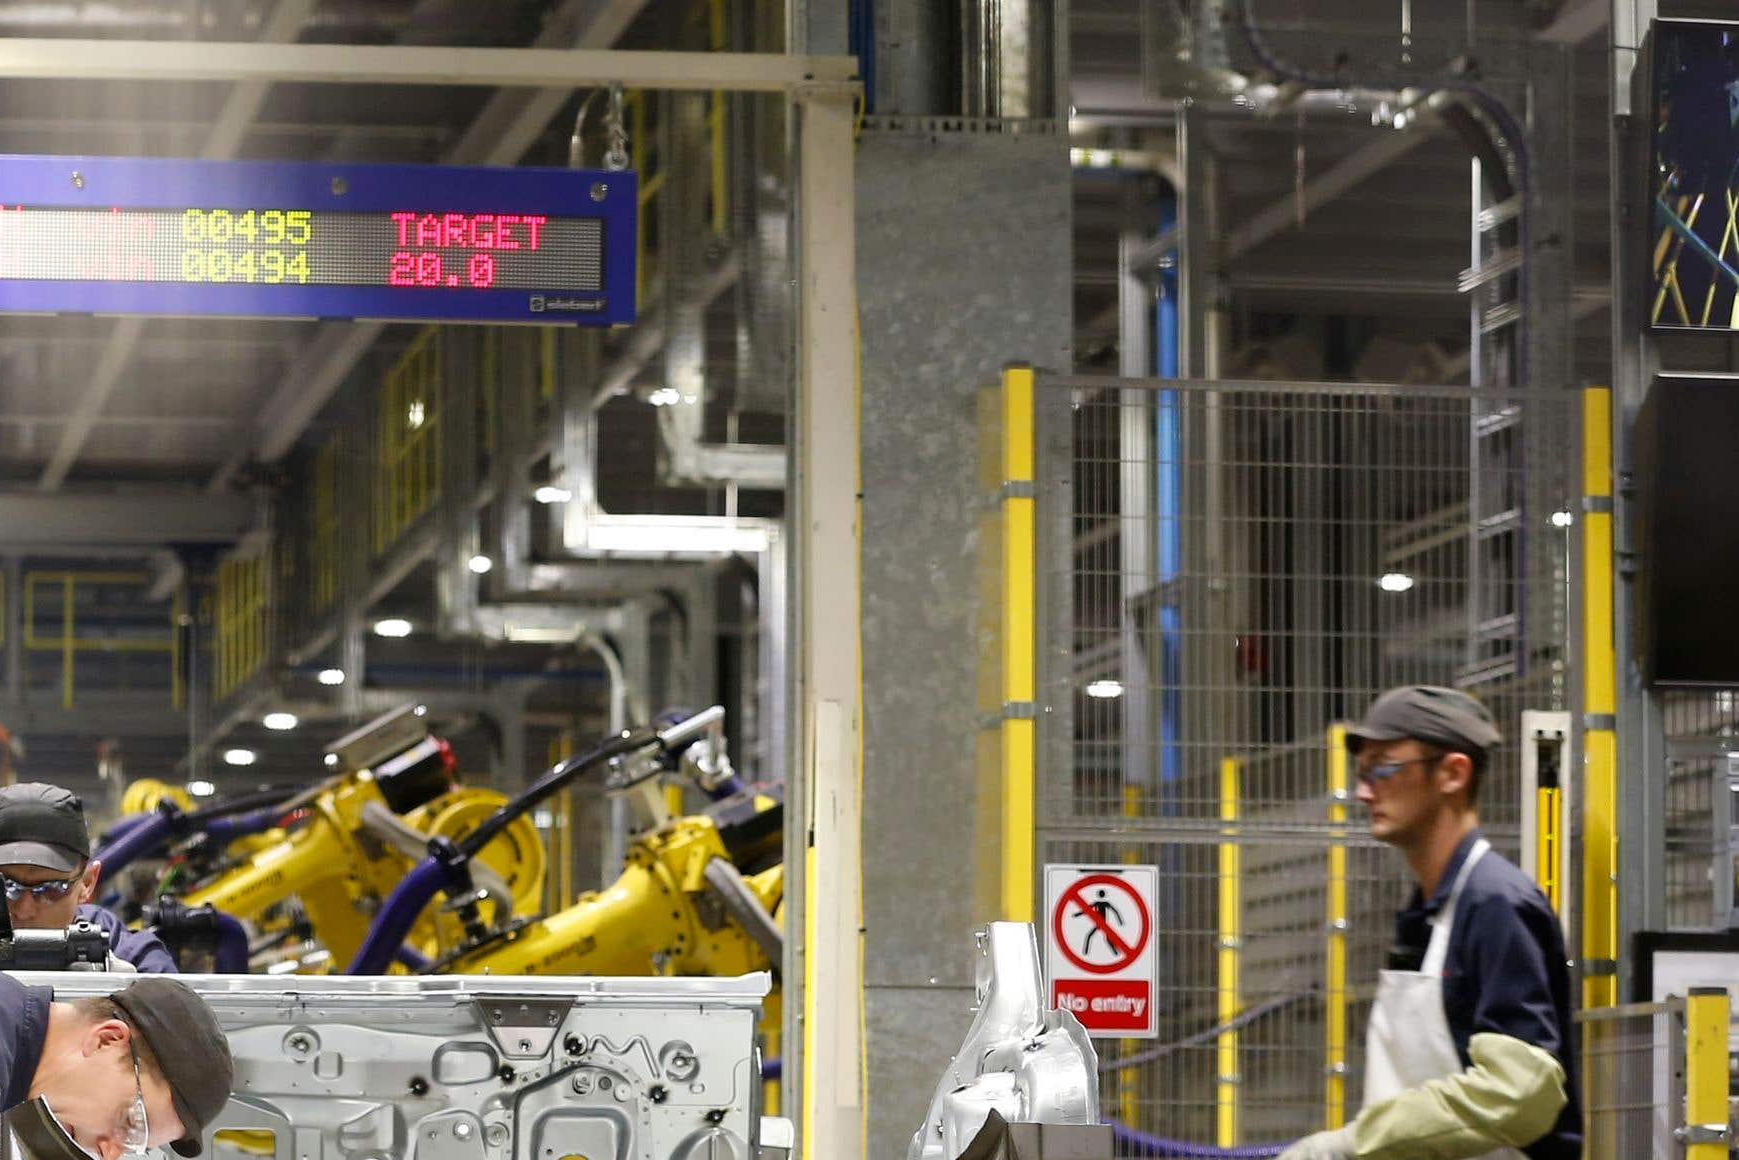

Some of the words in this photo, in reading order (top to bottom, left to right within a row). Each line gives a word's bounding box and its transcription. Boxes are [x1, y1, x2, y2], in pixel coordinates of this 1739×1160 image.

[182, 208, 312, 244] 00495
[390, 212, 548, 250] TARGET
[182, 248, 311, 284] 00494
[390, 252, 495, 287] 20.0
[1057, 993, 1088, 1012] No
[1090, 995, 1147, 1017] entry
